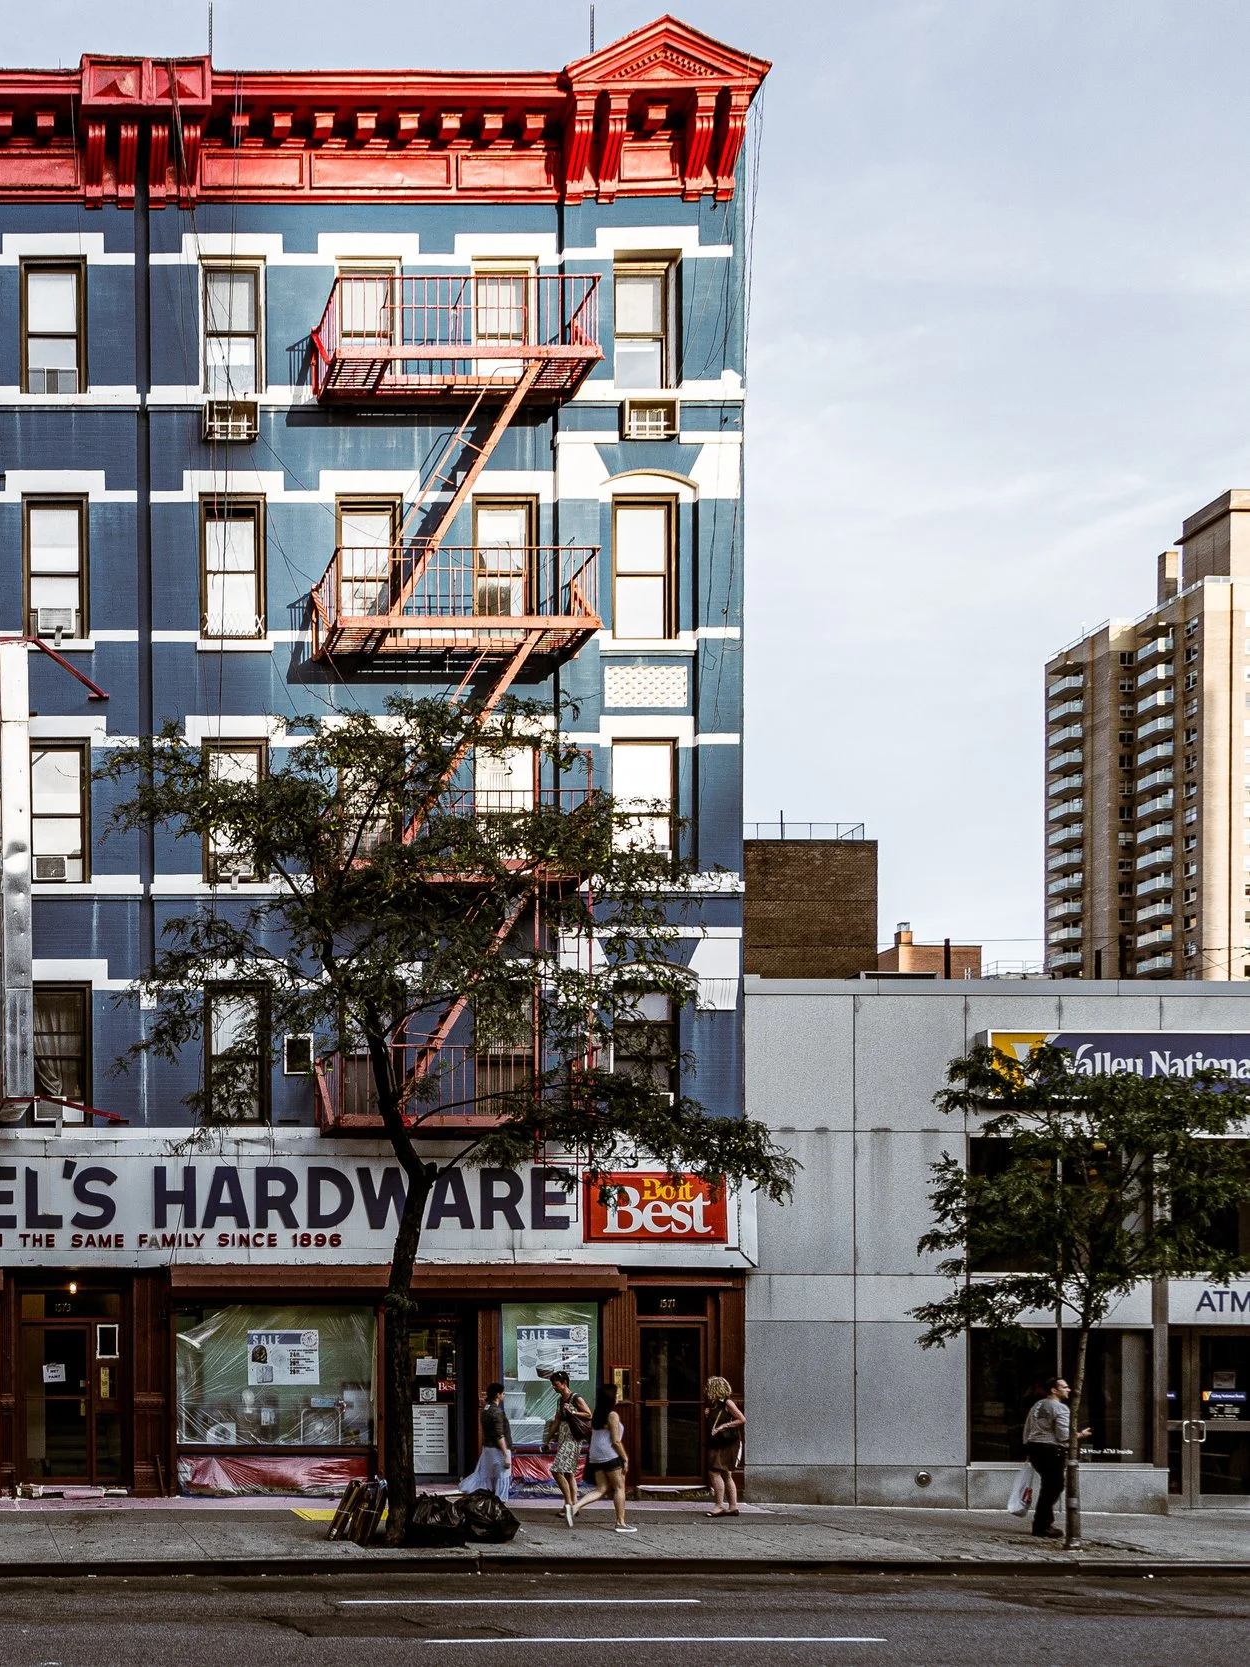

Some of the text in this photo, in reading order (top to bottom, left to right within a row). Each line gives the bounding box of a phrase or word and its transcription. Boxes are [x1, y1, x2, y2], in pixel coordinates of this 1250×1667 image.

[153, 1165, 571, 1231] HARDWARE
[642, 1178, 676, 1200] Do
[603, 1186, 712, 1233] Best
[19, 1233, 55, 1248] THE
[71, 1233, 125, 1248] SAME
[138, 1233, 206, 1248] FAMILY
[217, 1233, 278, 1248] SINCE
[292, 1233, 343, 1248] 1896
[1195, 1290, 1250, 1312] ATM
[253, 1334, 280, 1345] SALE
[521, 1329, 549, 1340] SALE
[438, 1382, 456, 1391] Best
